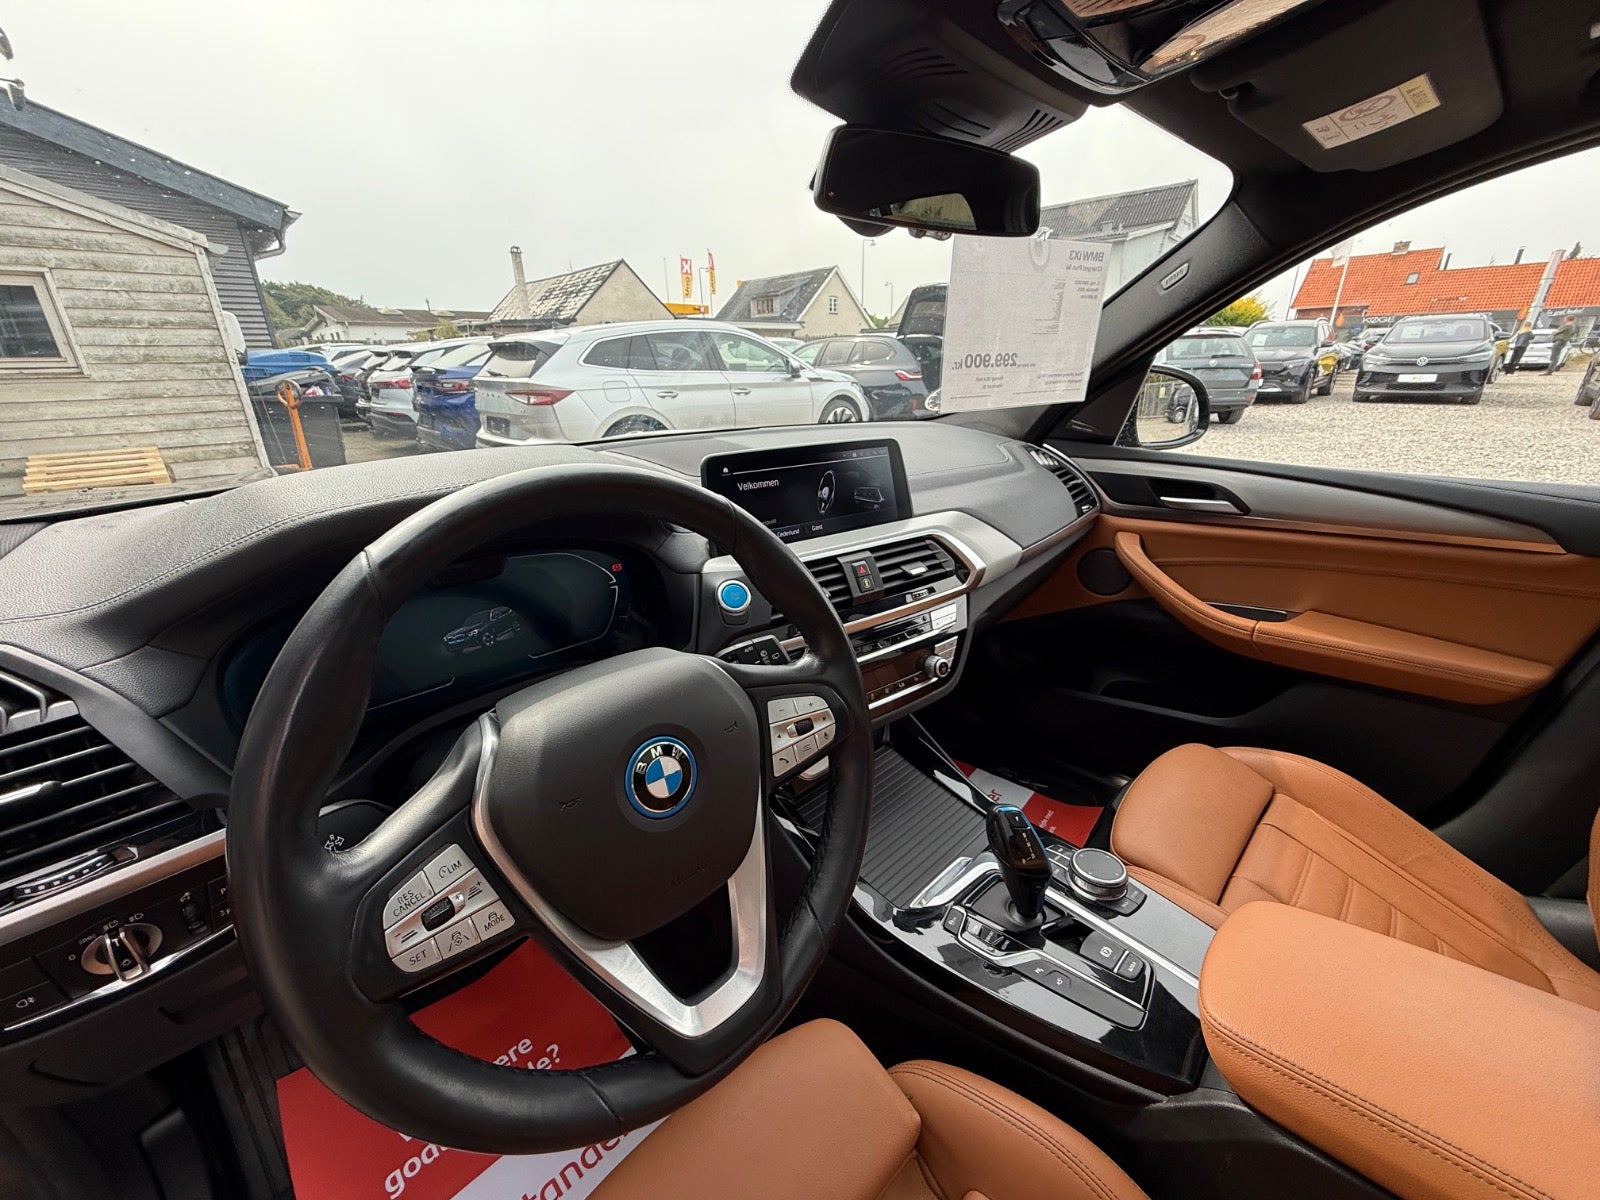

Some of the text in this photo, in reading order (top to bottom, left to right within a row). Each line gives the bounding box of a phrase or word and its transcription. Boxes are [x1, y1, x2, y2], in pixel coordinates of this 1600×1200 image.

[737, 479, 780, 491] Velkommen
[635, 745, 686, 775] BMW
[447, 860, 463, 875] LIM
[392, 893, 426, 918] CANCEL
[397, 889, 415, 905] RES
[483, 914, 506, 932] MODE
[408, 949, 427, 966] SET
